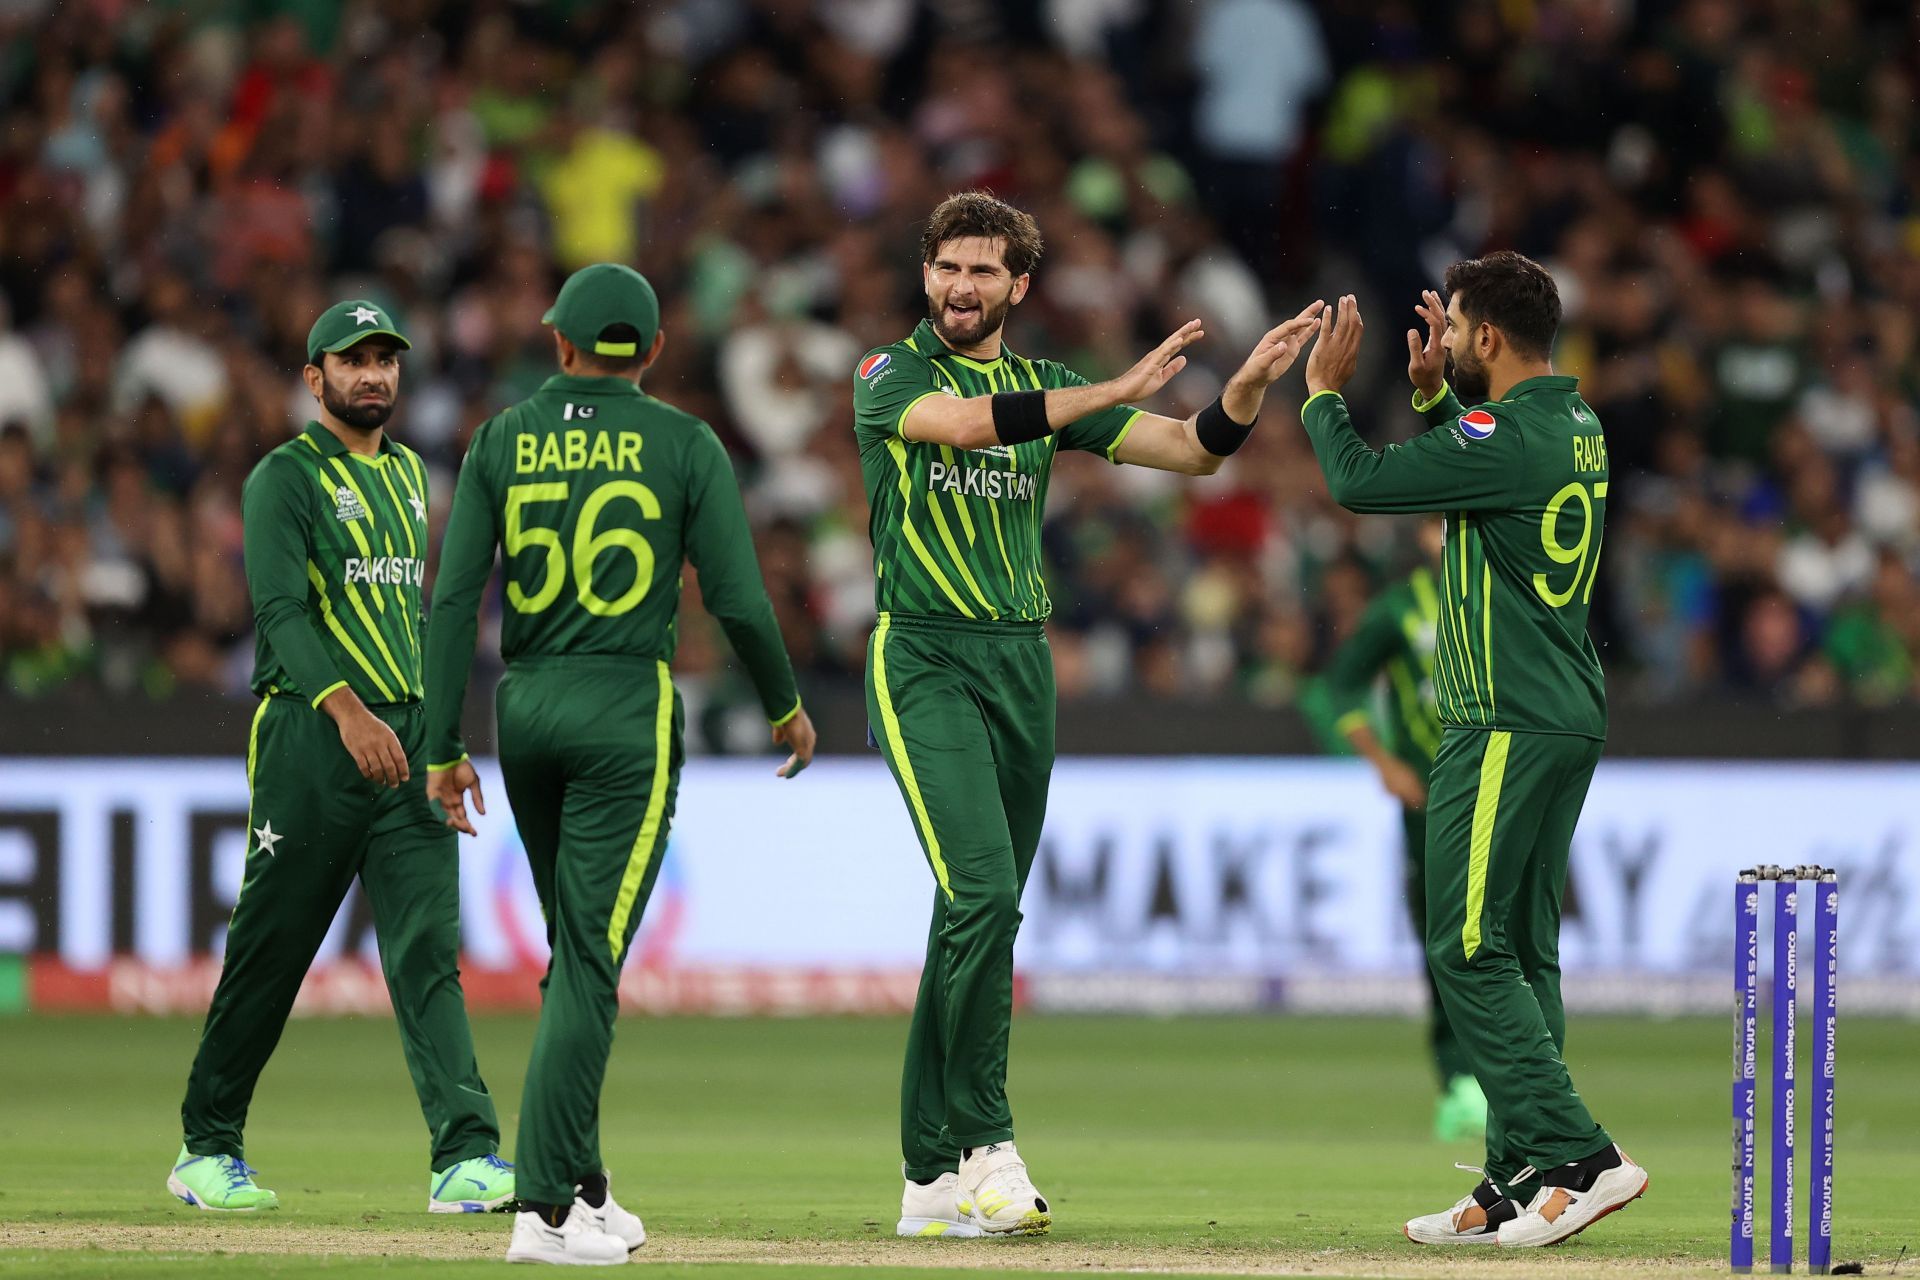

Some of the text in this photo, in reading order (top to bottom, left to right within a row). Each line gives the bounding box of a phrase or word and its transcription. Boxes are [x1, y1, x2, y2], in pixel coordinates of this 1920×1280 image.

[869, 368, 893, 391] pepsi
[1448, 427, 1469, 447] epsi
[515, 429, 643, 474] BABAR
[928, 461, 1037, 501] PAKISTAN
[1572, 434, 1606, 473] RAUF
[504, 480, 662, 617] 56
[1532, 481, 1608, 608] 97
[1036, 824, 1346, 954] MAKE
[1746, 930, 1757, 1062] BYJU'S NISSAN
[1785, 931, 1796, 1080] Booking.com aramco
[1826, 930, 1837, 1060] BYJU'S NISSAN
[1744, 1089, 1754, 1221] BYJU'S NISSAN
[1784, 1089, 1794, 1237] Booking.com aramco
[1823, 1089, 1834, 1219] BYJU'S NISSAN
